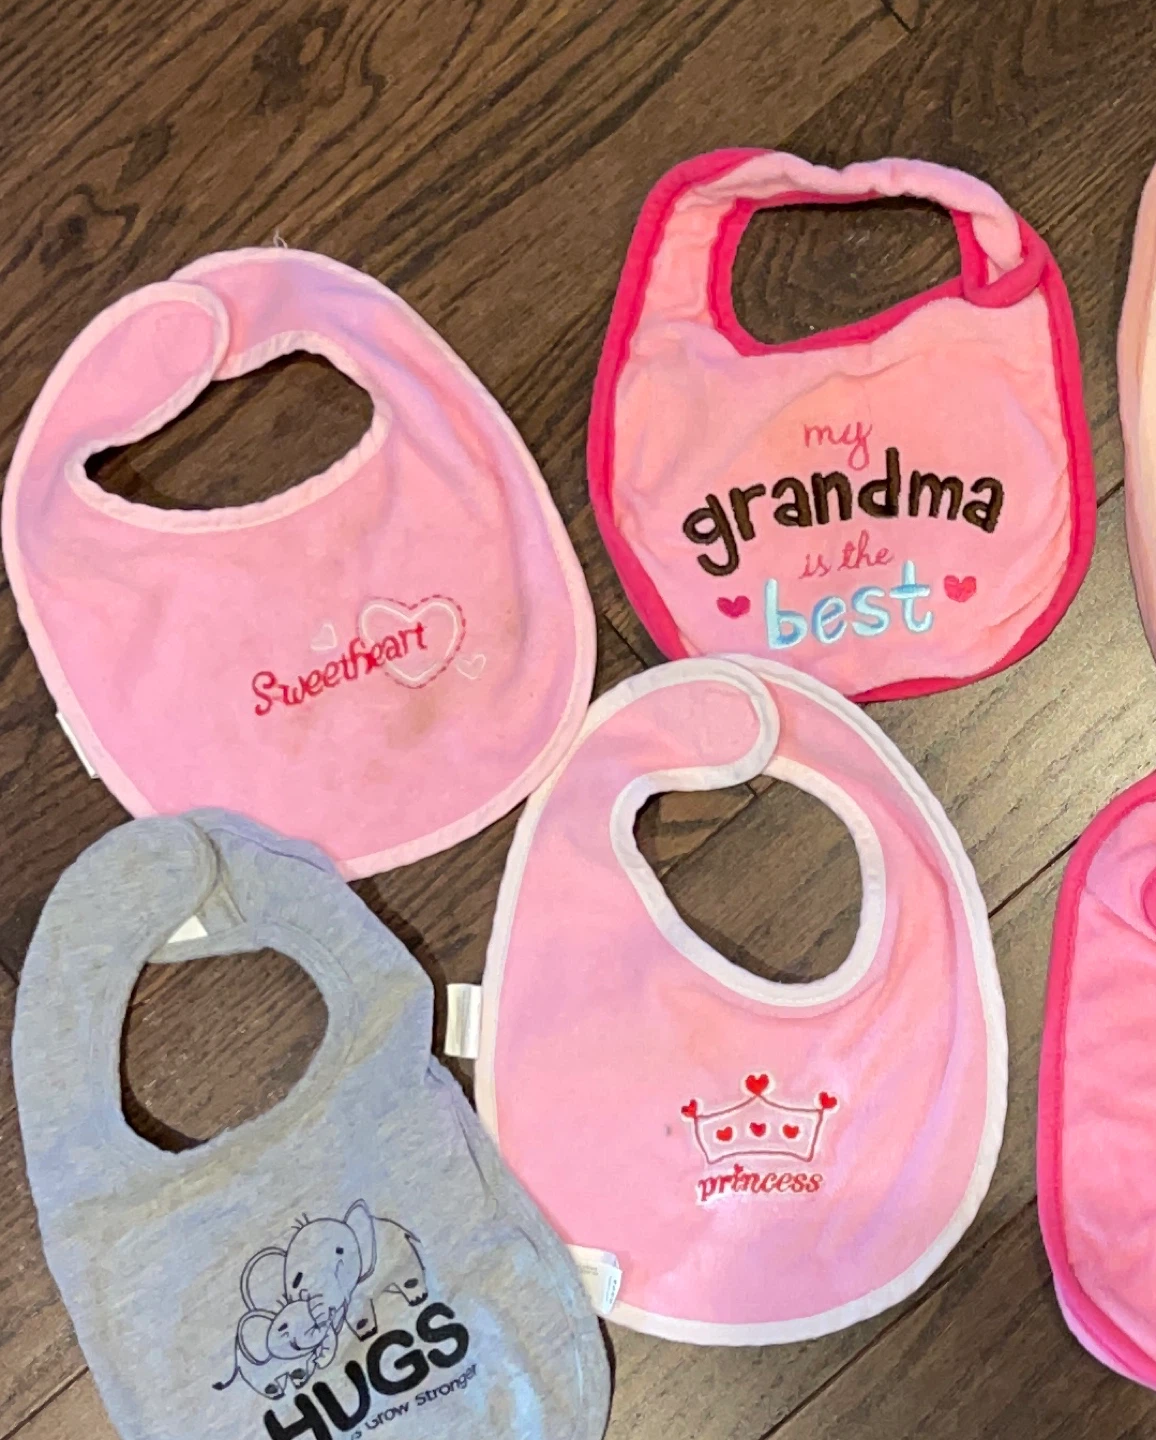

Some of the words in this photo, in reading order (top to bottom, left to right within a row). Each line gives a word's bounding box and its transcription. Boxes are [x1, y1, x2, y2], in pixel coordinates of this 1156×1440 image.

[804, 420, 873, 472] my
[682, 446, 1005, 577] grandma
[798, 552, 831, 580] is
[837, 528, 896, 571] the
[763, 559, 935, 651] best
[251, 621, 428, 717] Sweetheart
[697, 1163, 824, 1202] princess
[414, 1363, 478, 1407] Stronger
